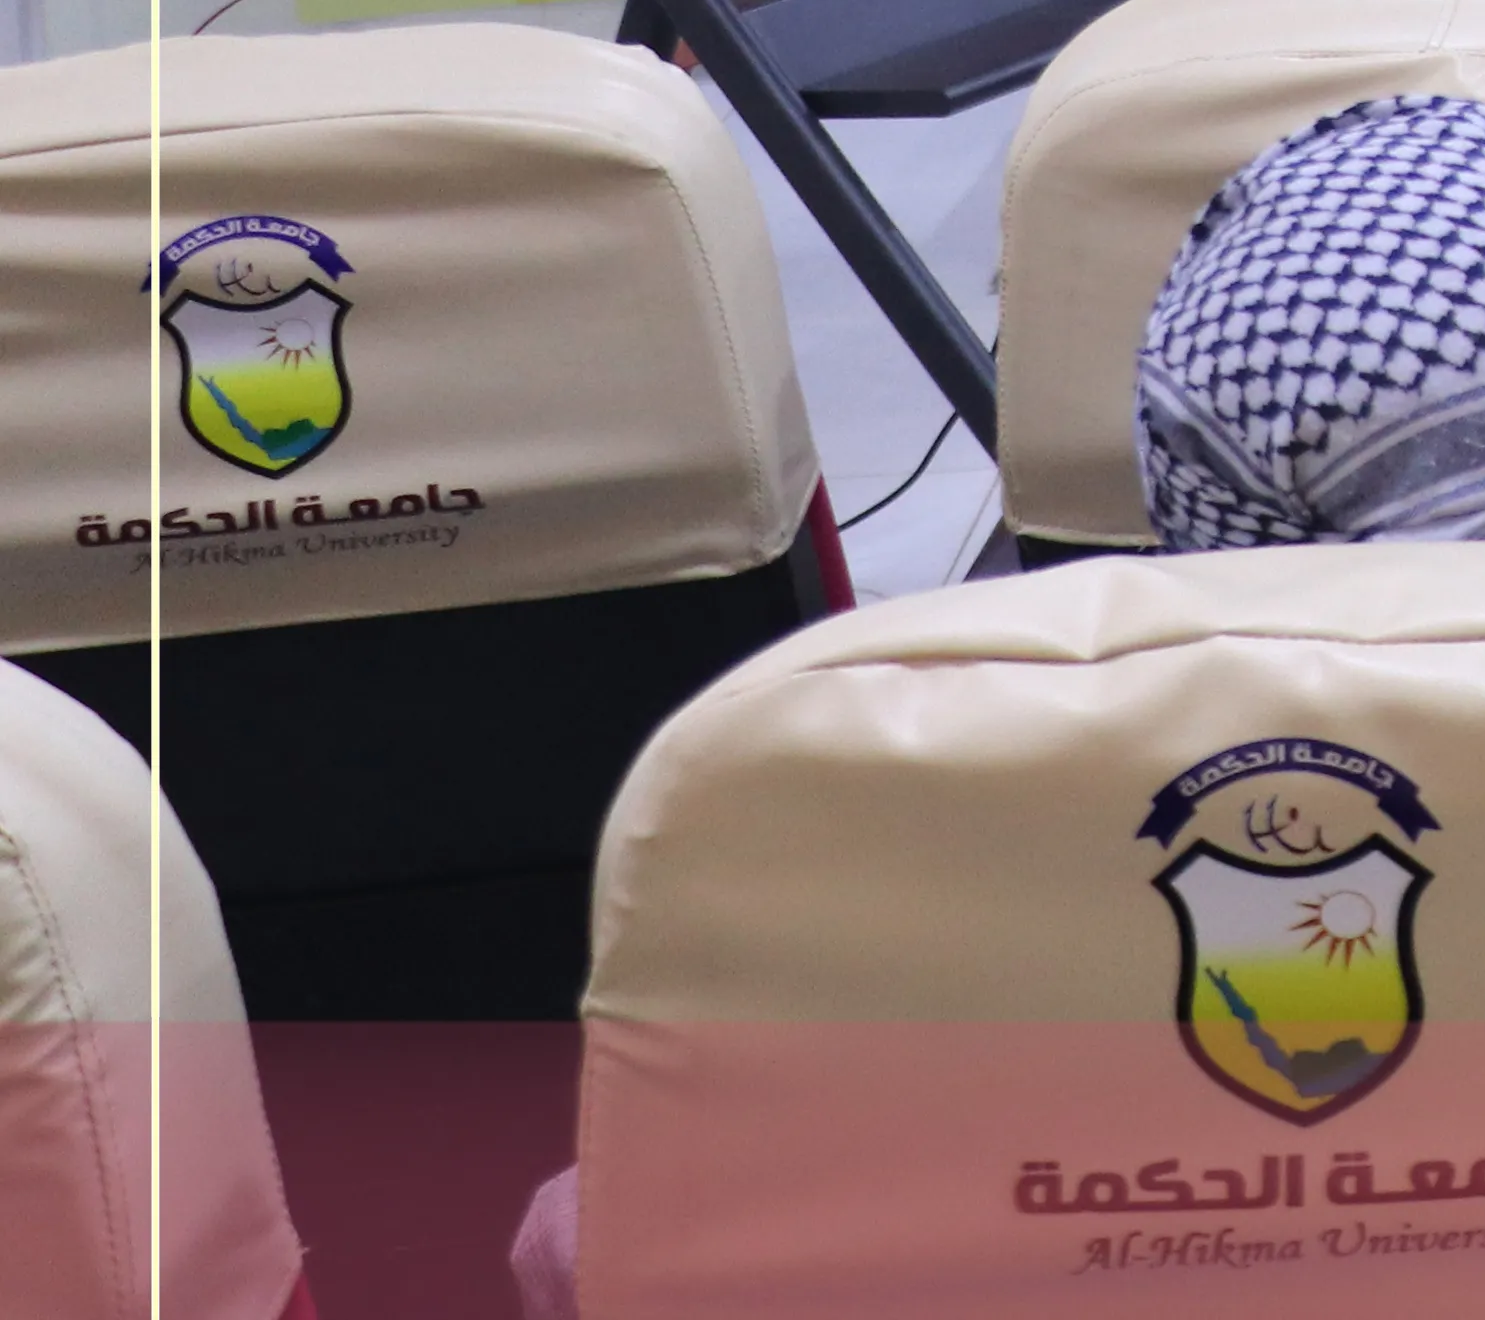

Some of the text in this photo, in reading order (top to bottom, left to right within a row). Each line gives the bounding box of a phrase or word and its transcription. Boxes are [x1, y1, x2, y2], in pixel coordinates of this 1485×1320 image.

[247, 218, 320, 246] جامعة
[75, 484, 485, 548] جامعة الحكمة
[1178, 743, 1396, 798] جامعة الحكمة
[1013, 1153, 1305, 1216] الحكمة
[1072, 1230, 1304, 1276] Al-Hikma
